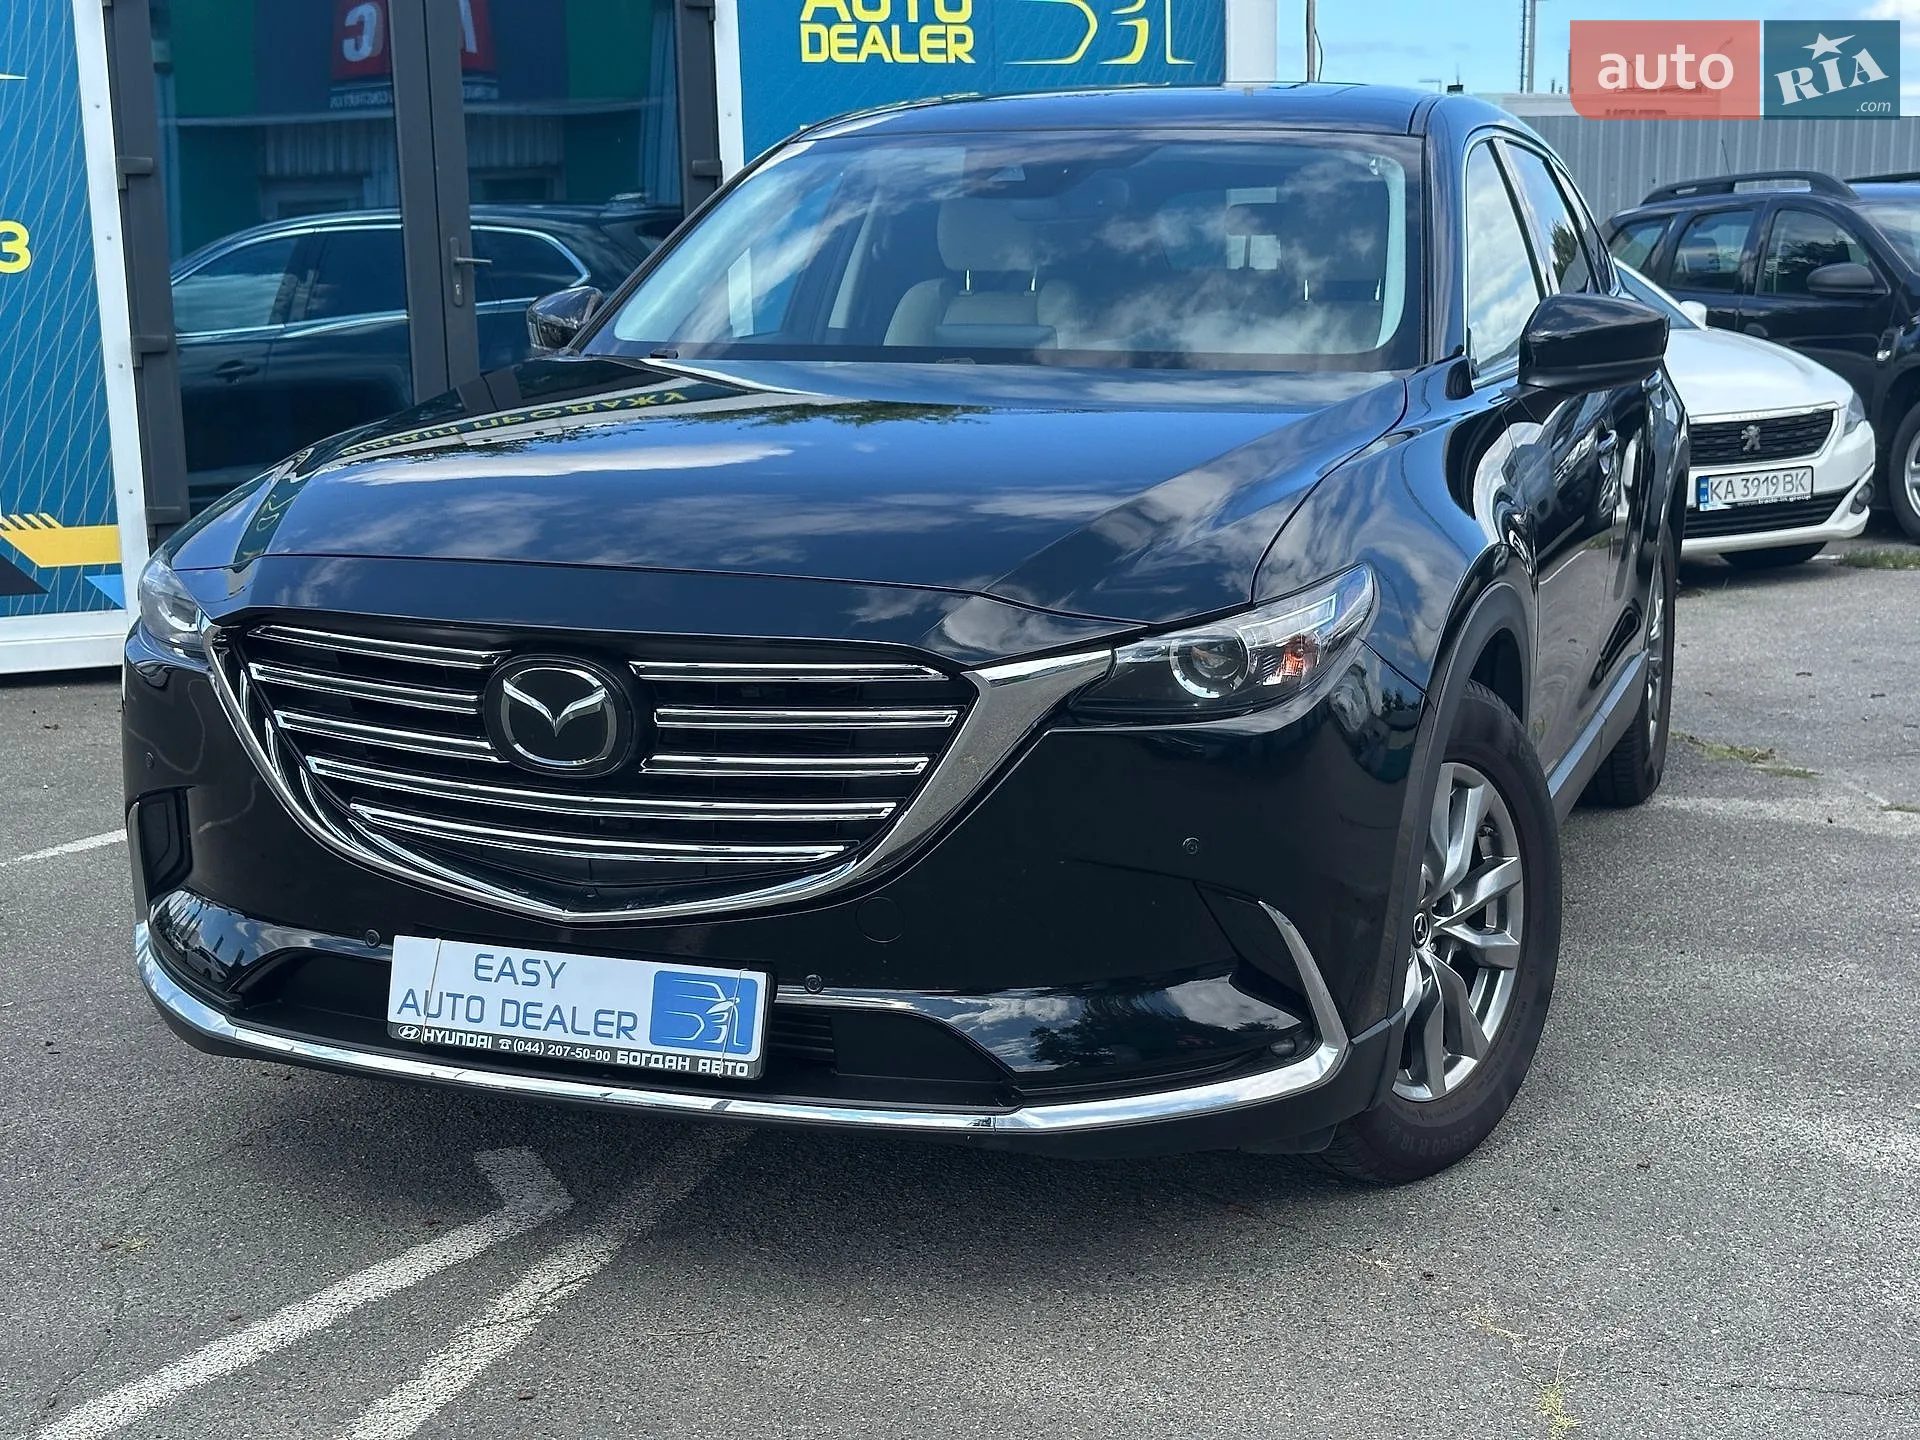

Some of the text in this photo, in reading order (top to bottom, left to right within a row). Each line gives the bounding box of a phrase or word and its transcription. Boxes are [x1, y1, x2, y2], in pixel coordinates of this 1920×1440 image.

[800, 24, 976, 64] DEALER
[1709, 472, 1808, 501] KA 3919 BK
[474, 953, 567, 989] EASY
[396, 988, 637, 1041] AUTO DEALER
[424, 1028, 611, 1062] HYUNDAI (044) 207-50-00
[616, 1051, 749, 1077] БОГДАН АВТО
